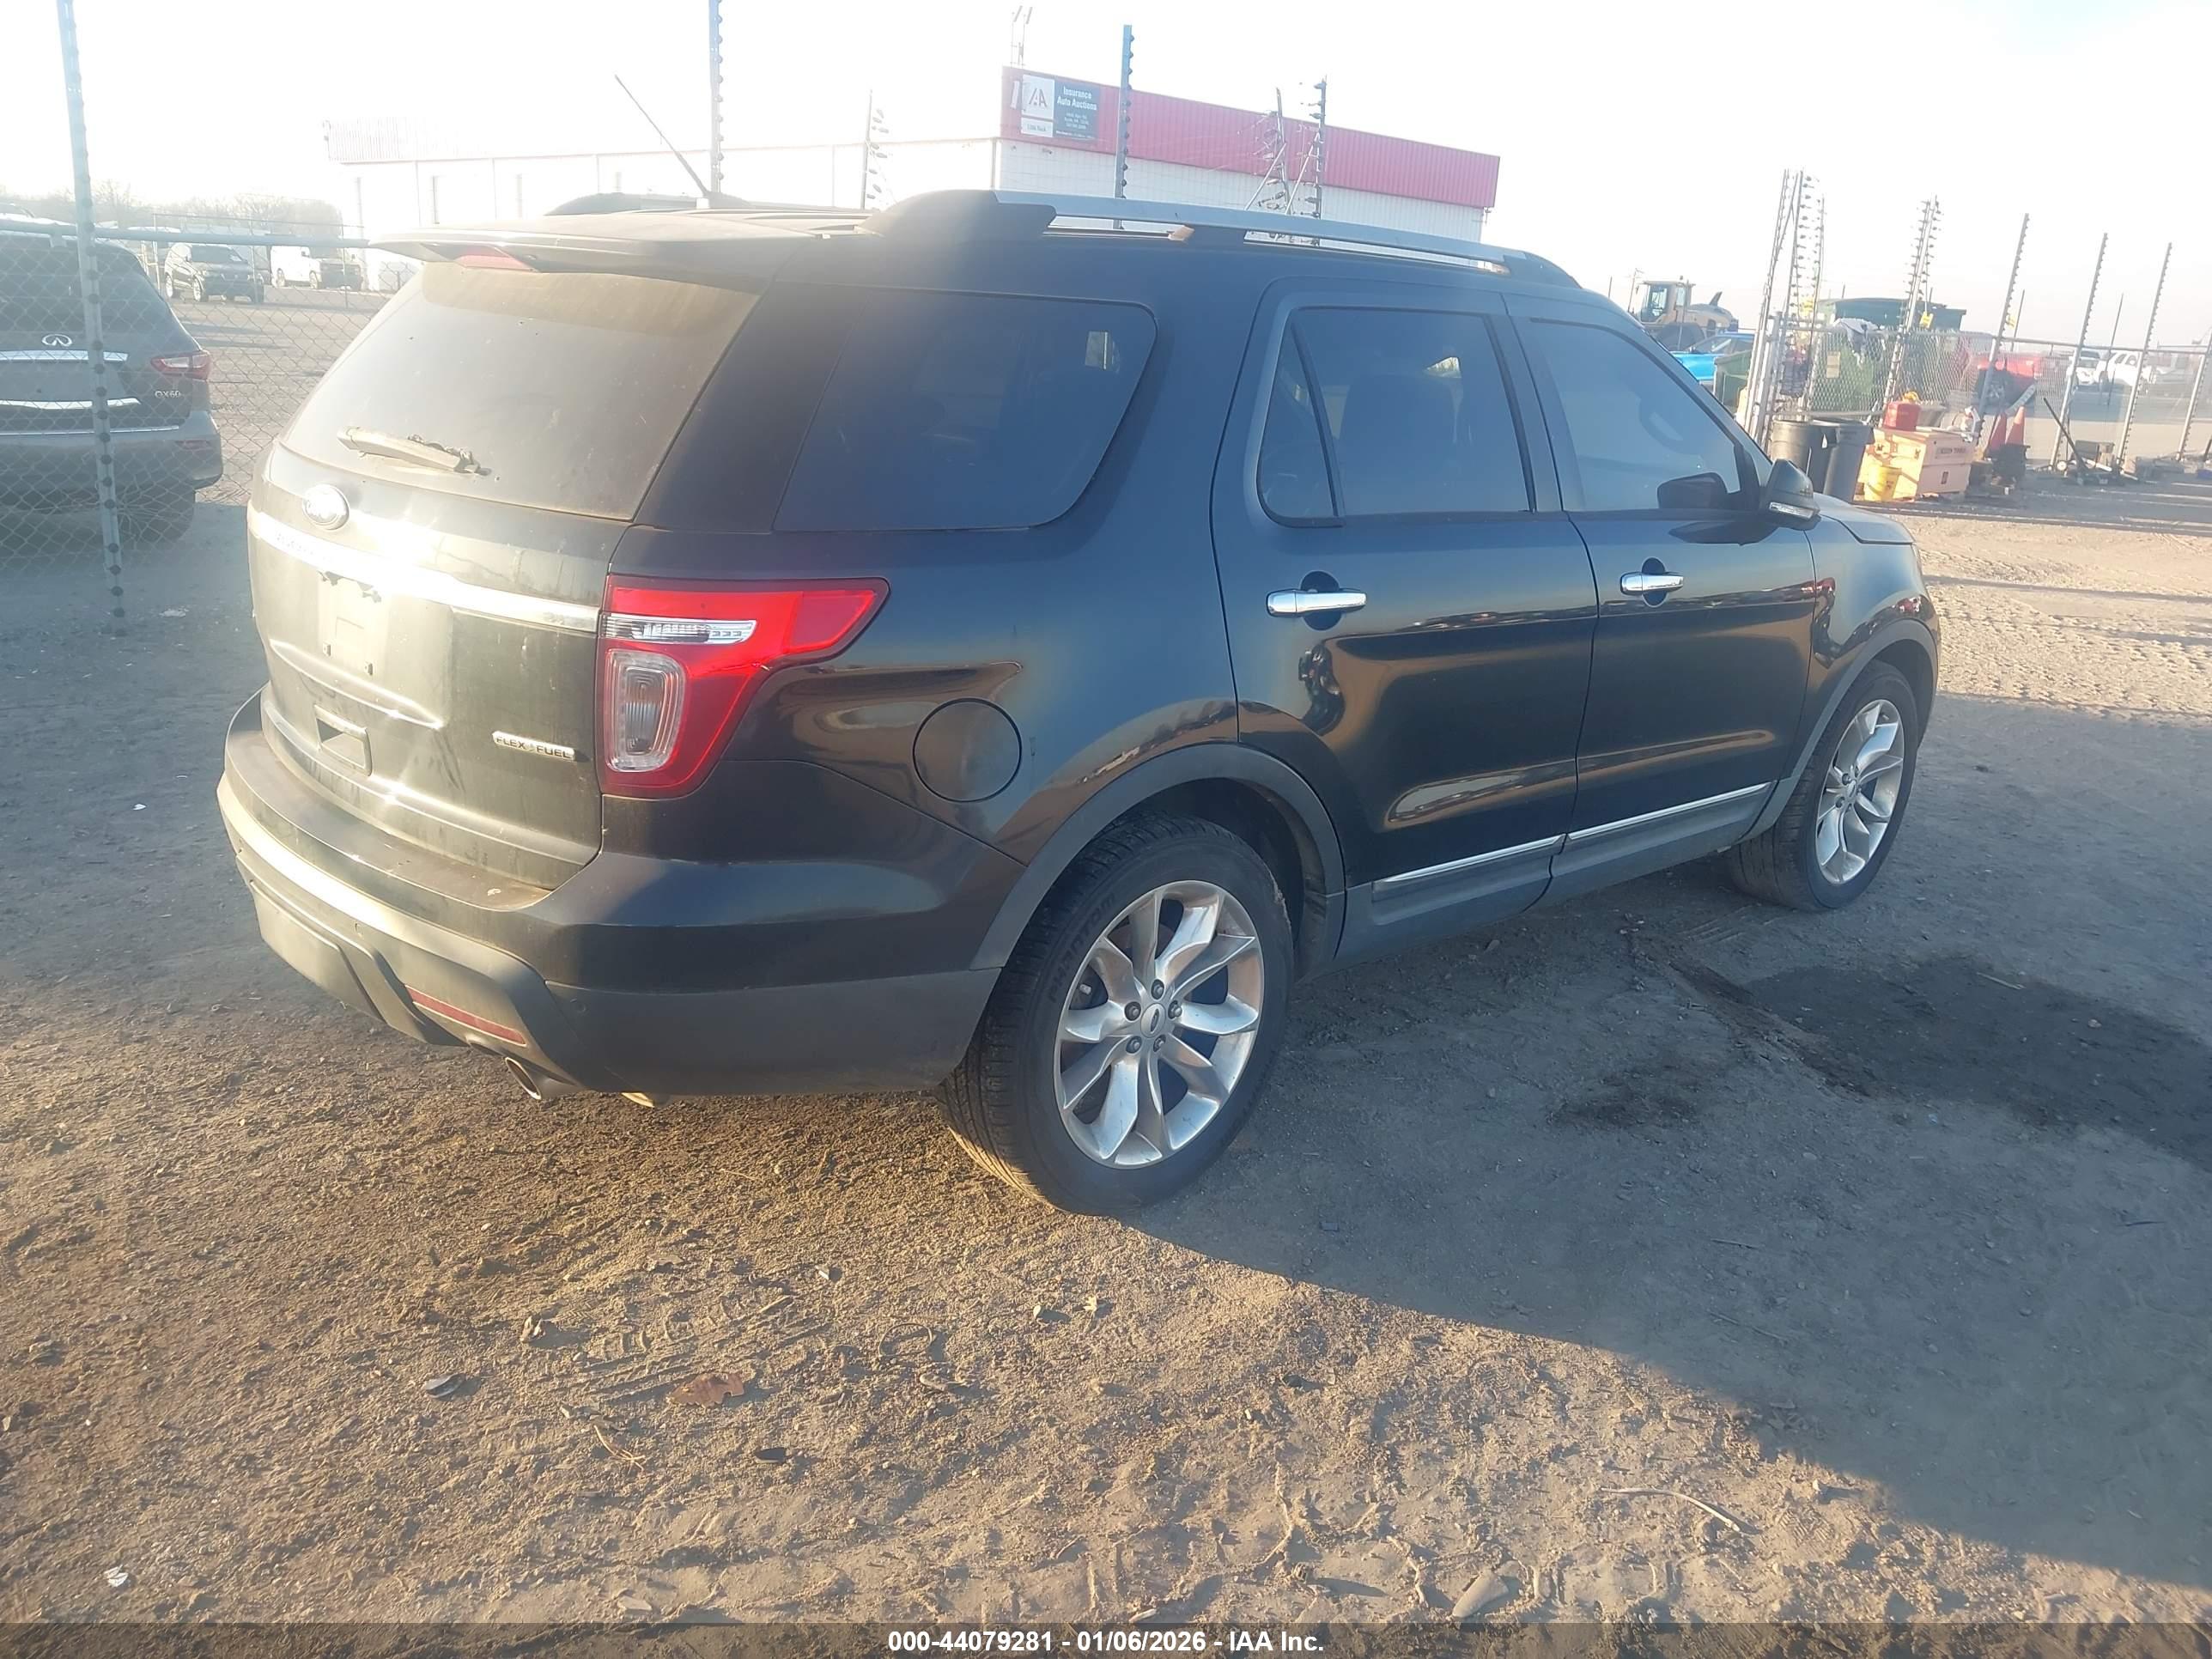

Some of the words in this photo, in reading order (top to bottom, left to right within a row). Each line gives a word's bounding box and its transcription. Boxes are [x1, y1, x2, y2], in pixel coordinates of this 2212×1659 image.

[1063, 85, 1092, 99] Insurance
[1057, 95, 1071, 106] Auto
[1072, 97, 1097, 111] Auctions
[495, 737, 527, 750] FLEX
[536, 744, 571, 759] FUEL
